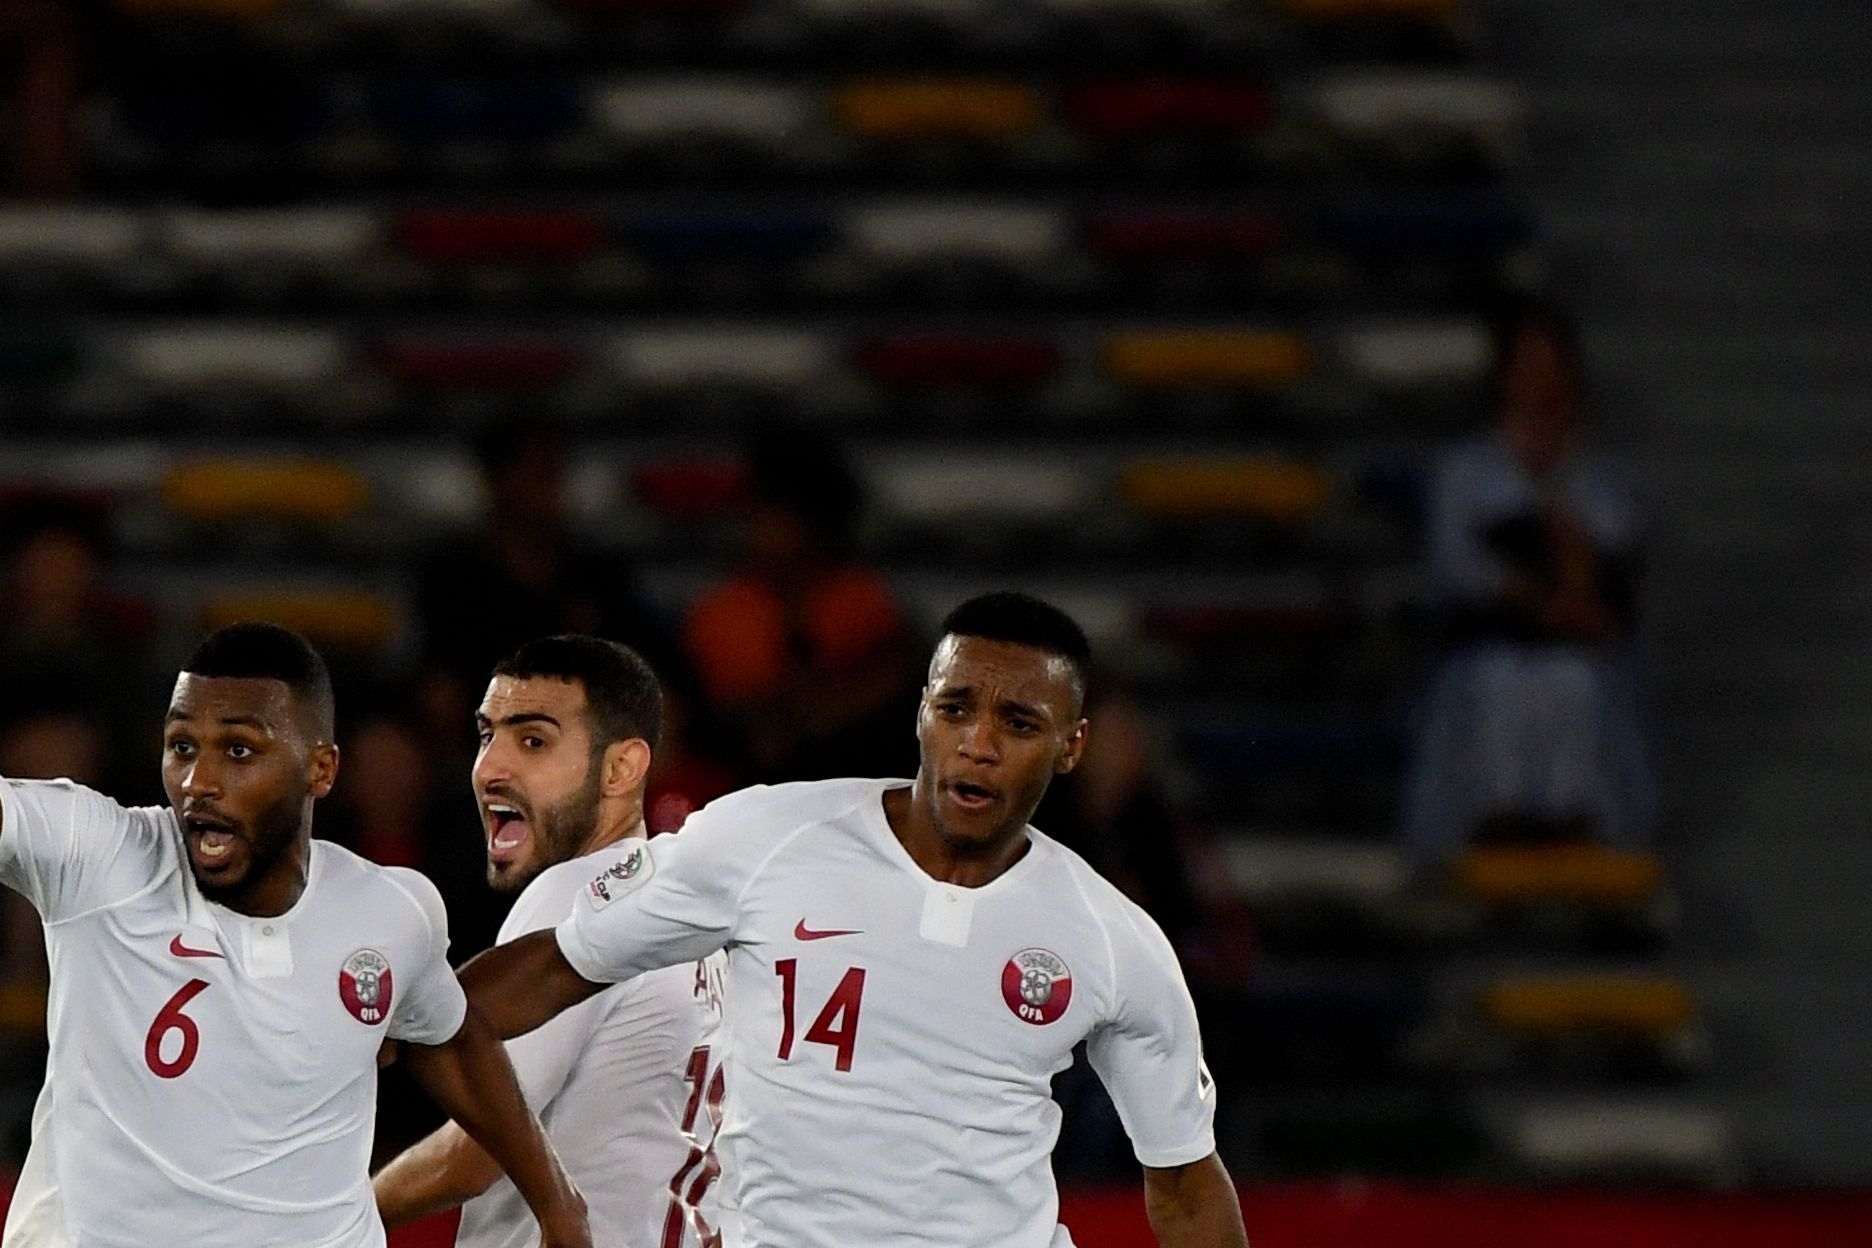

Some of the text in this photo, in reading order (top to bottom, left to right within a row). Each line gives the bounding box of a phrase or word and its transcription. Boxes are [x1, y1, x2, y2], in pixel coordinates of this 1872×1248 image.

[145, 978, 211, 1078] 6
[774, 958, 867, 1073] 14
[1018, 1003, 1045, 1022] QFA
